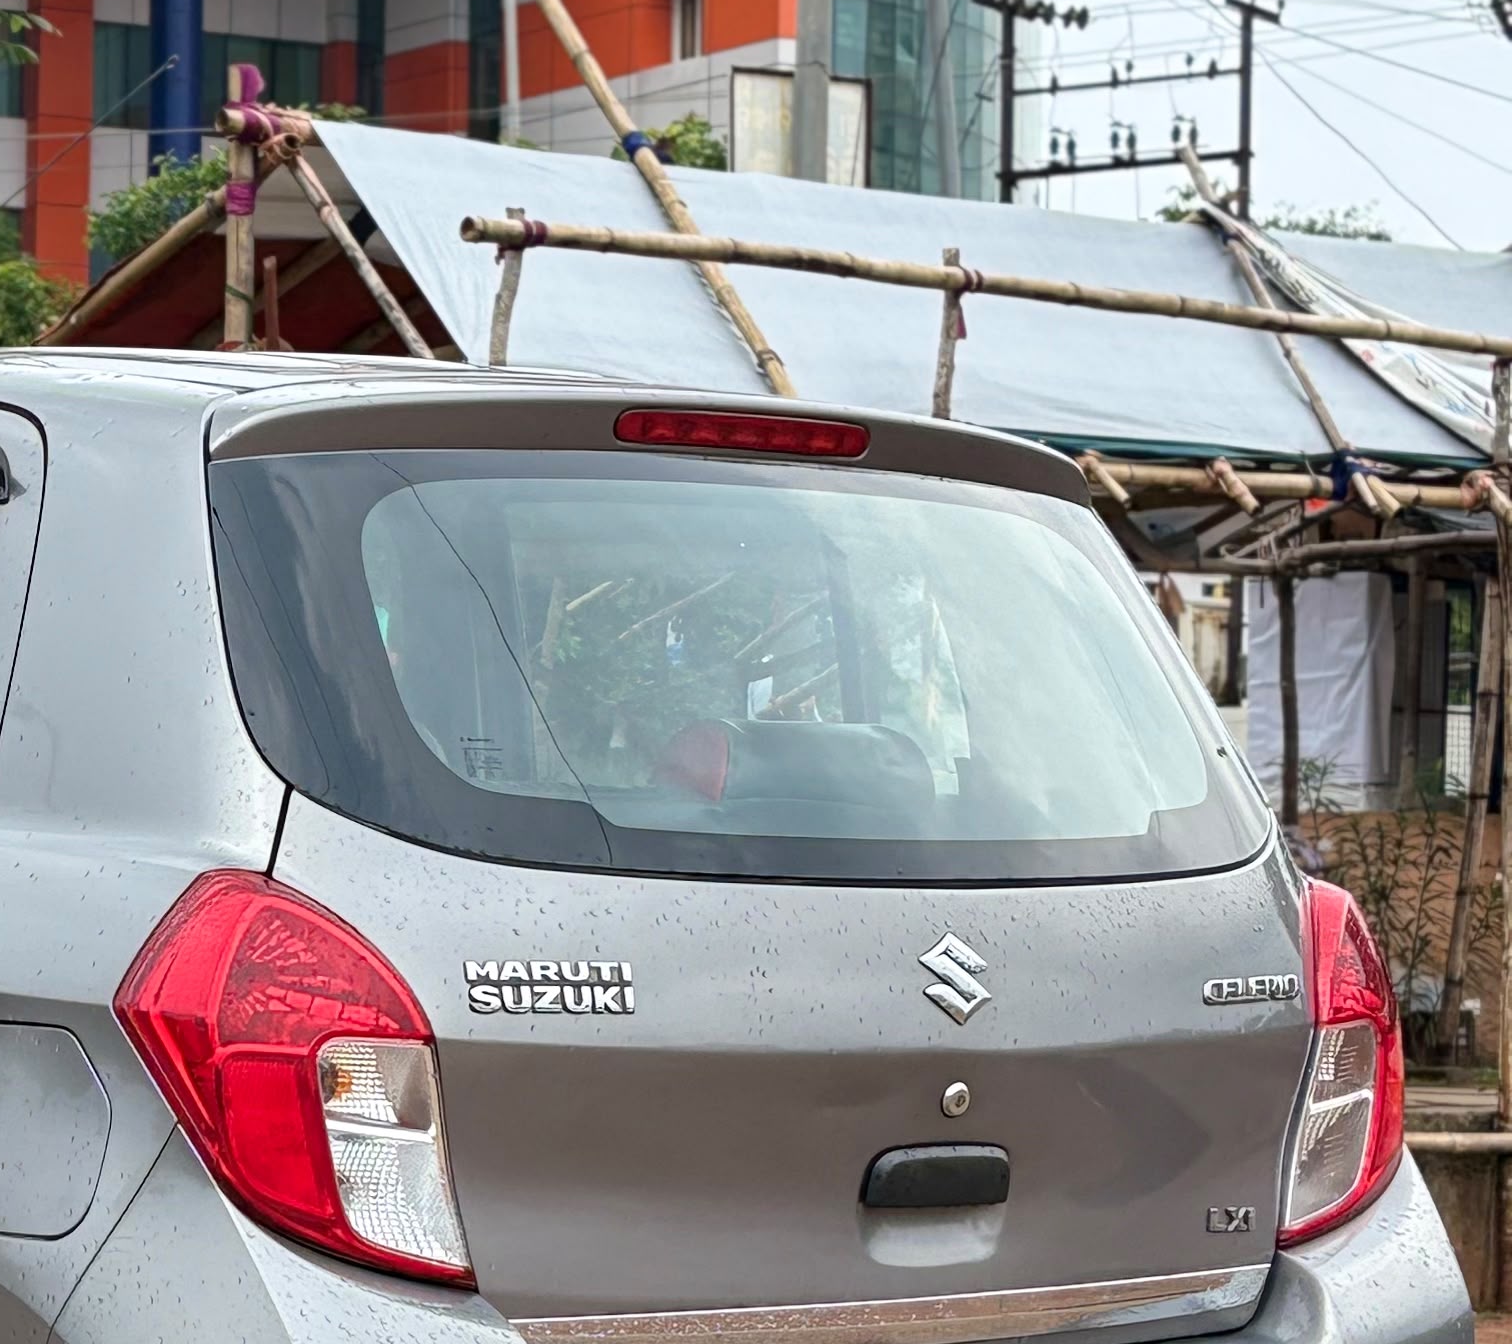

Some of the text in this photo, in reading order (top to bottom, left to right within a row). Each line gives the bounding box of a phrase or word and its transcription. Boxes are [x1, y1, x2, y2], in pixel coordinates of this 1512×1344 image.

[464, 960, 633, 982] MARUTI
[469, 984, 635, 1014] SUZUKI
[1203, 974, 1300, 1005] CELERIO
